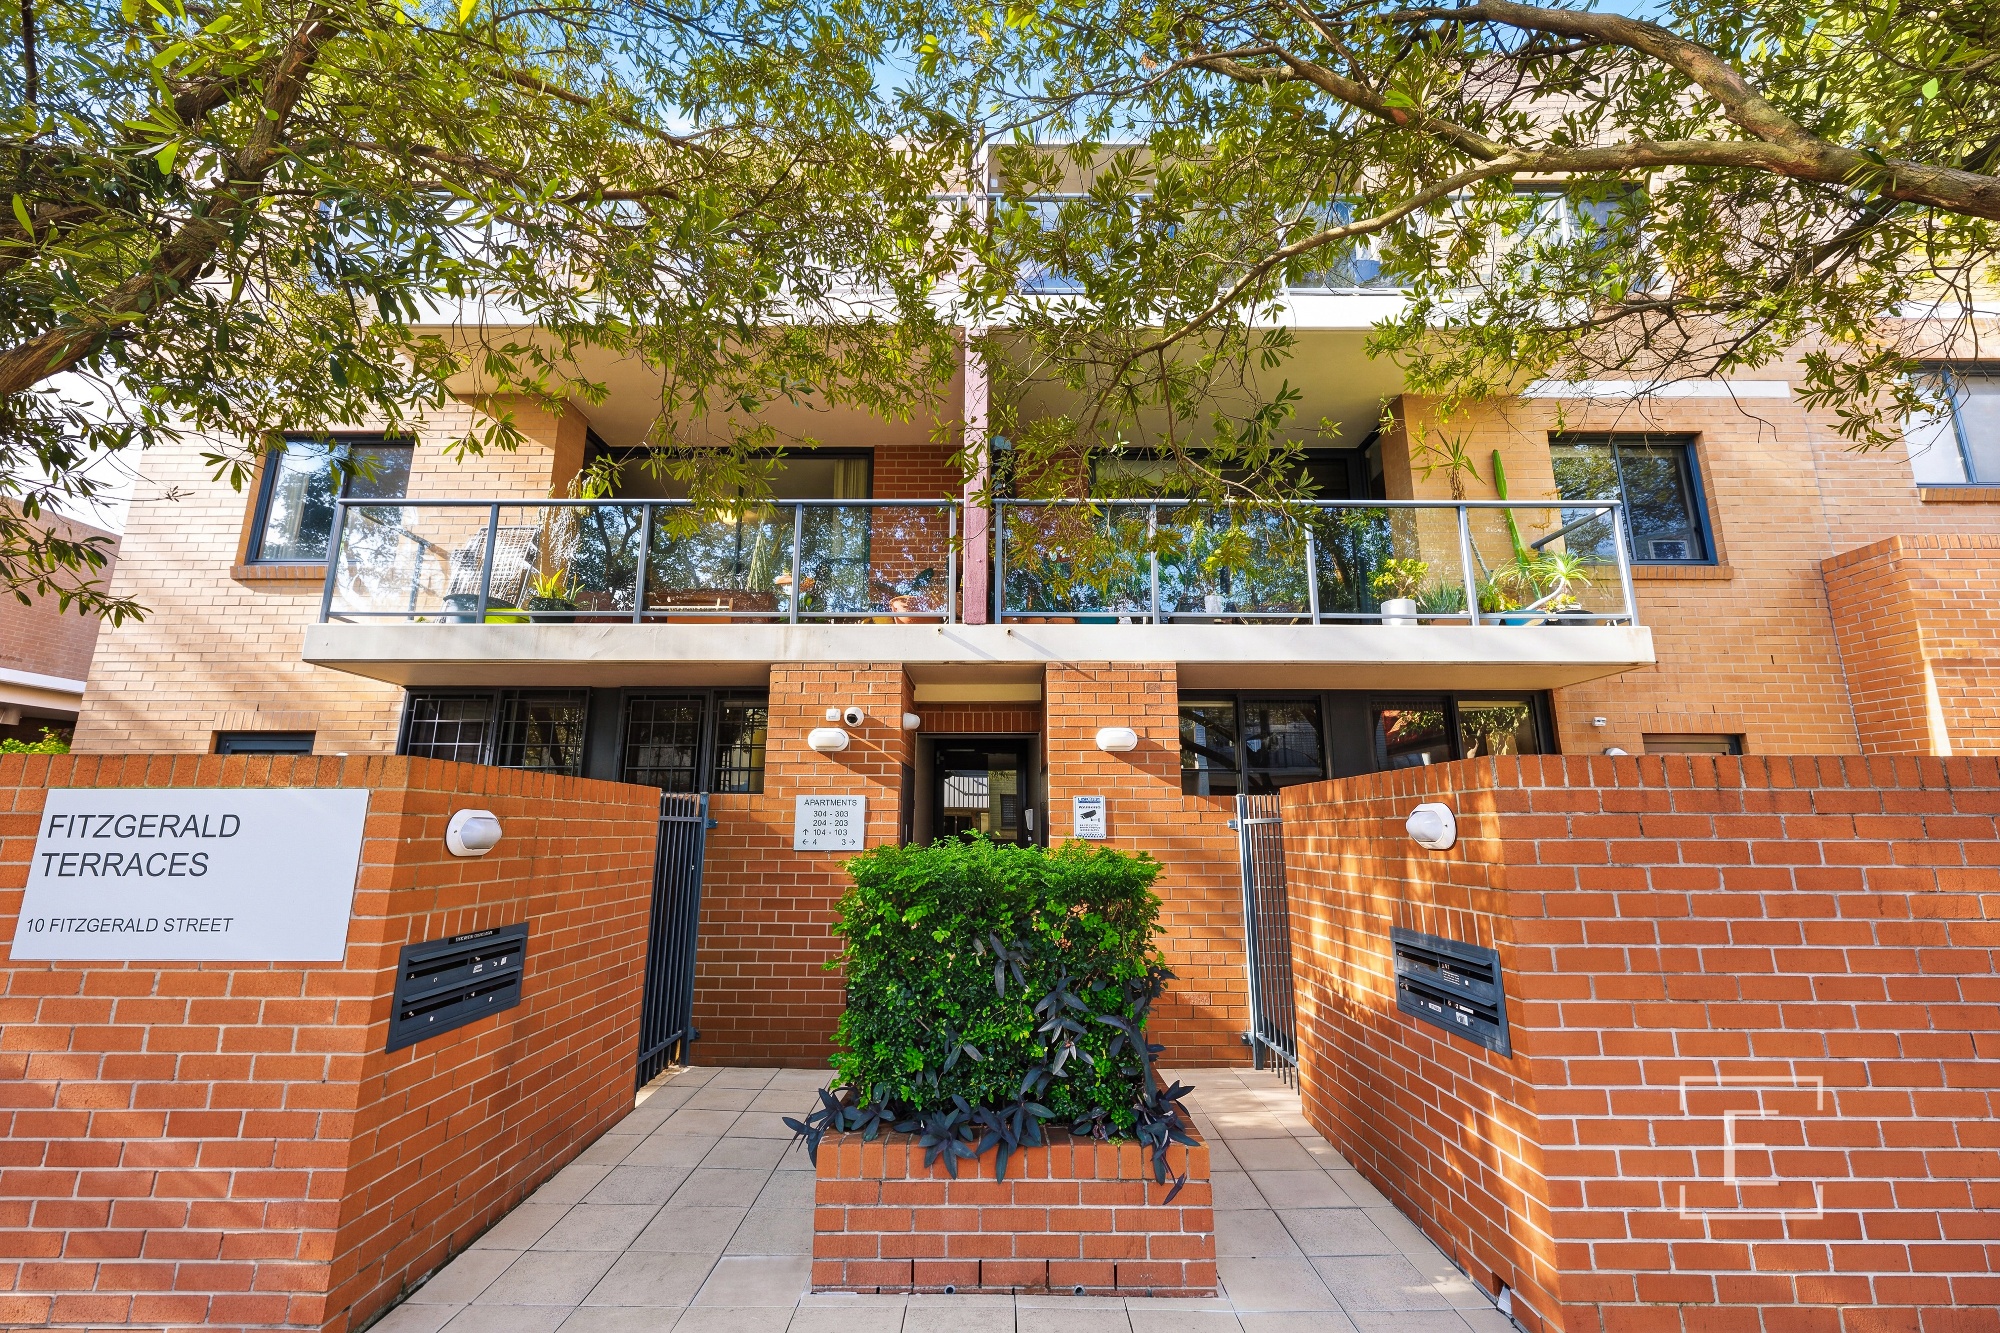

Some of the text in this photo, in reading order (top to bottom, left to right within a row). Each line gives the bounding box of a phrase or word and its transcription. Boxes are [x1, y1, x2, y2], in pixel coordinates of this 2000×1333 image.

[804, 799, 857, 807] APARTMENTS
[47, 814, 241, 839] FITZGERALD
[41, 852, 210, 877] TERRACES
[26, 918, 234, 933] 10 FITZGERALD STREET
